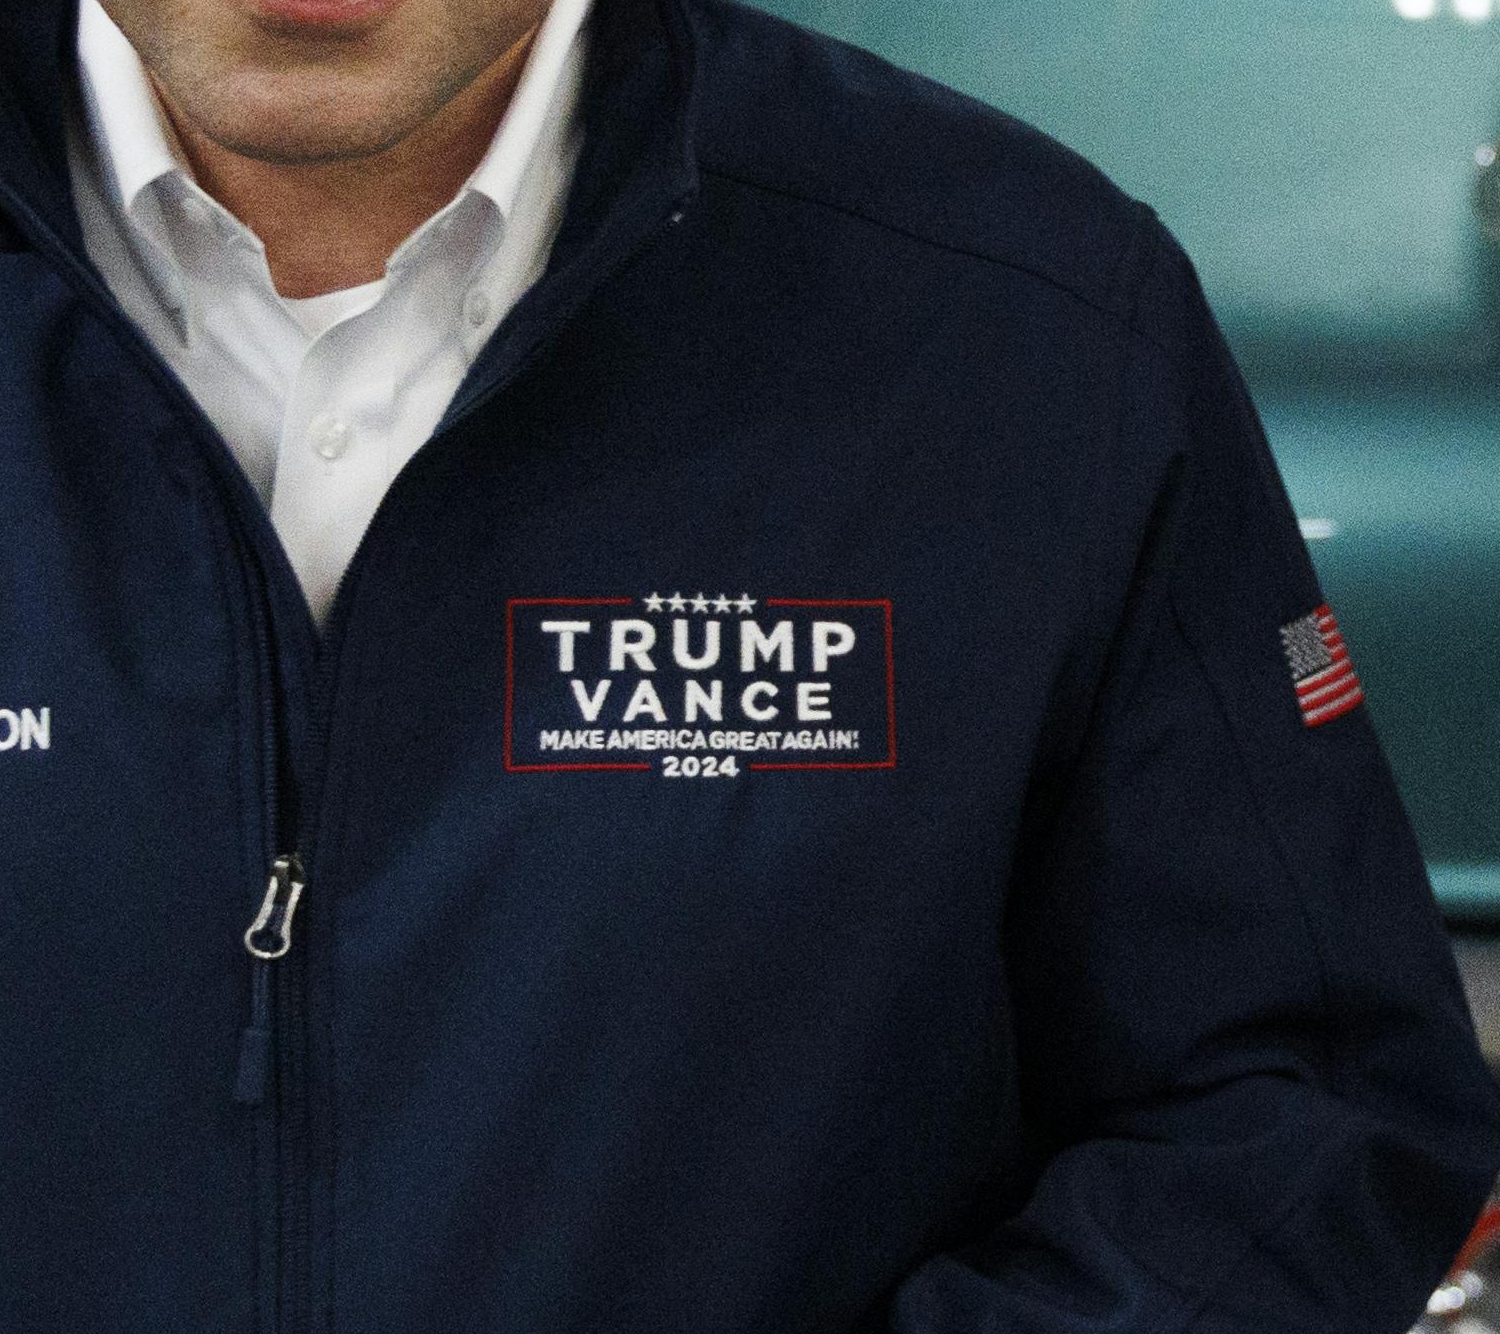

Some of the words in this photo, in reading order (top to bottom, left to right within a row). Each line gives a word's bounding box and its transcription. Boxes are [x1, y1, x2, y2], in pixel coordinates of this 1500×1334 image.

[541, 618, 857, 673] TRUMP
[570, 679, 833, 723] VANCE
[540, 729, 605, 751] MAKE
[606, 729, 708, 751] AMERICA
[708, 730, 782, 752] GREAT
[781, 729, 860, 751] AGAIN!
[662, 755, 741, 778] 2024
